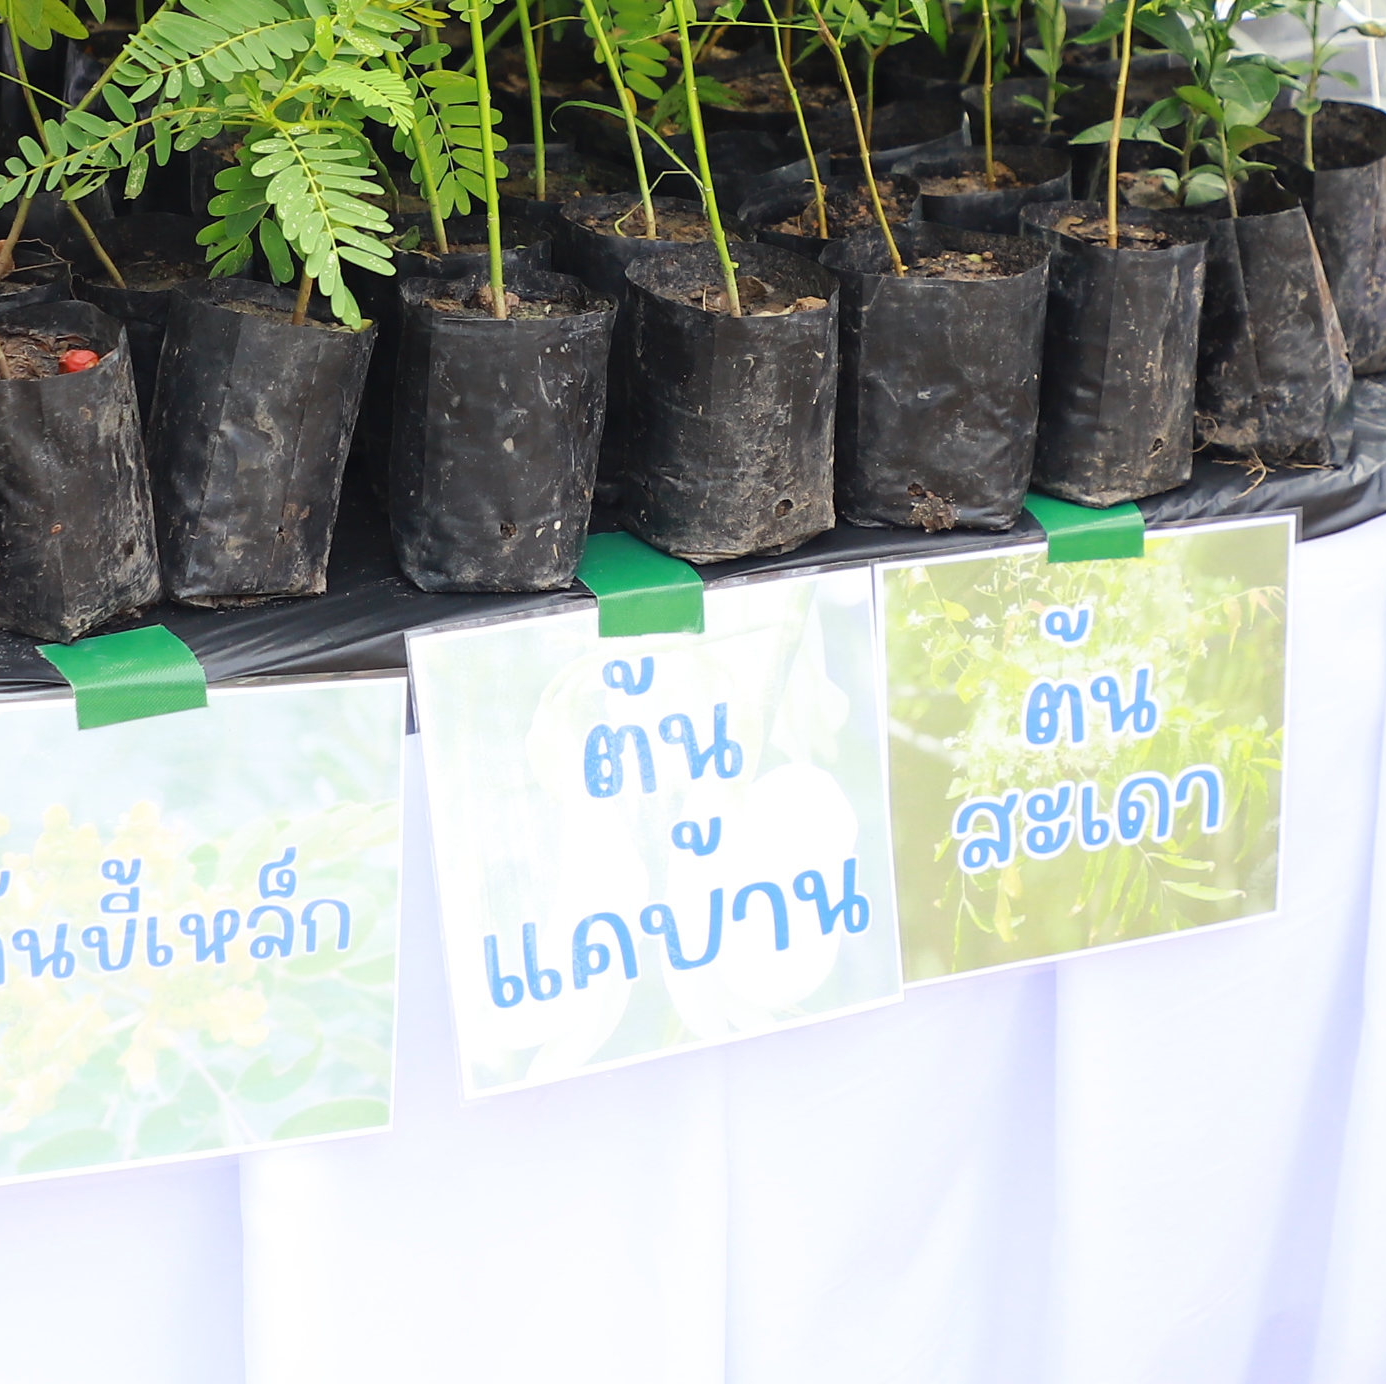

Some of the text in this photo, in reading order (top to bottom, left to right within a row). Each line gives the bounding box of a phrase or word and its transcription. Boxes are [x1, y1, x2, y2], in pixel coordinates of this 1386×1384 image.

[583, 655, 744, 799] ต้น
[1024, 608, 1158, 746] ต้น
[955, 768, 1221, 871] สะเดา
[482, 815, 870, 1009] แคบ้าน
